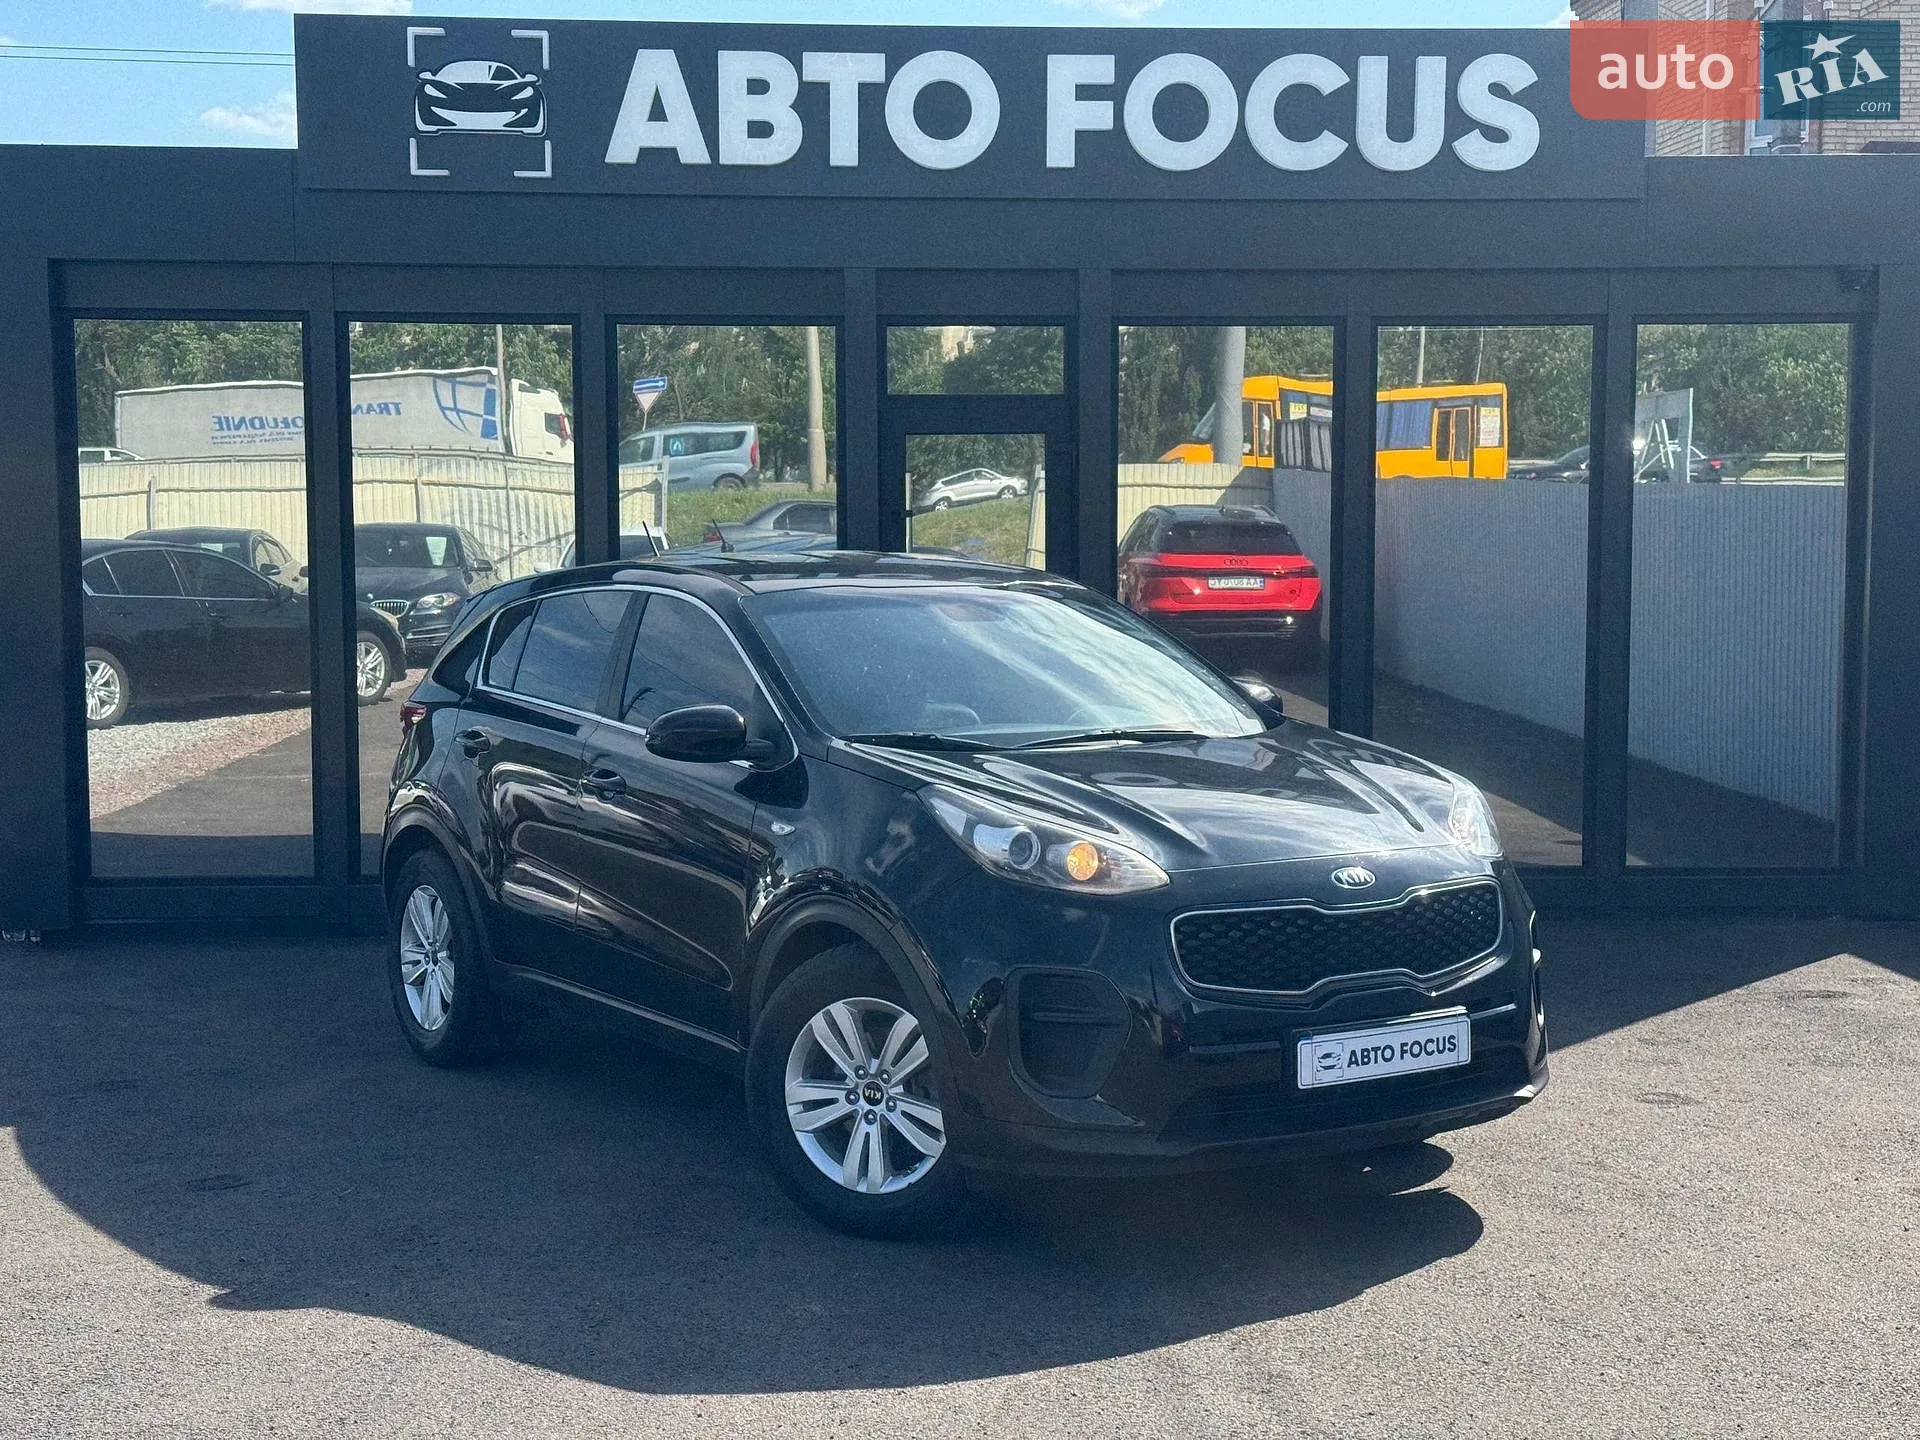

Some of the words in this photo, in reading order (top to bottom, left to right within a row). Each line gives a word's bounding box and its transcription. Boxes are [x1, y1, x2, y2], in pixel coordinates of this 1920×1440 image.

[604, 48, 1000, 169] АВТО
[1046, 53, 1540, 172] FOCUS
[1336, 869, 1371, 886] KIA
[1347, 1045, 1395, 1068] АВТО
[1400, 1035, 1457, 1061] FOCUS
